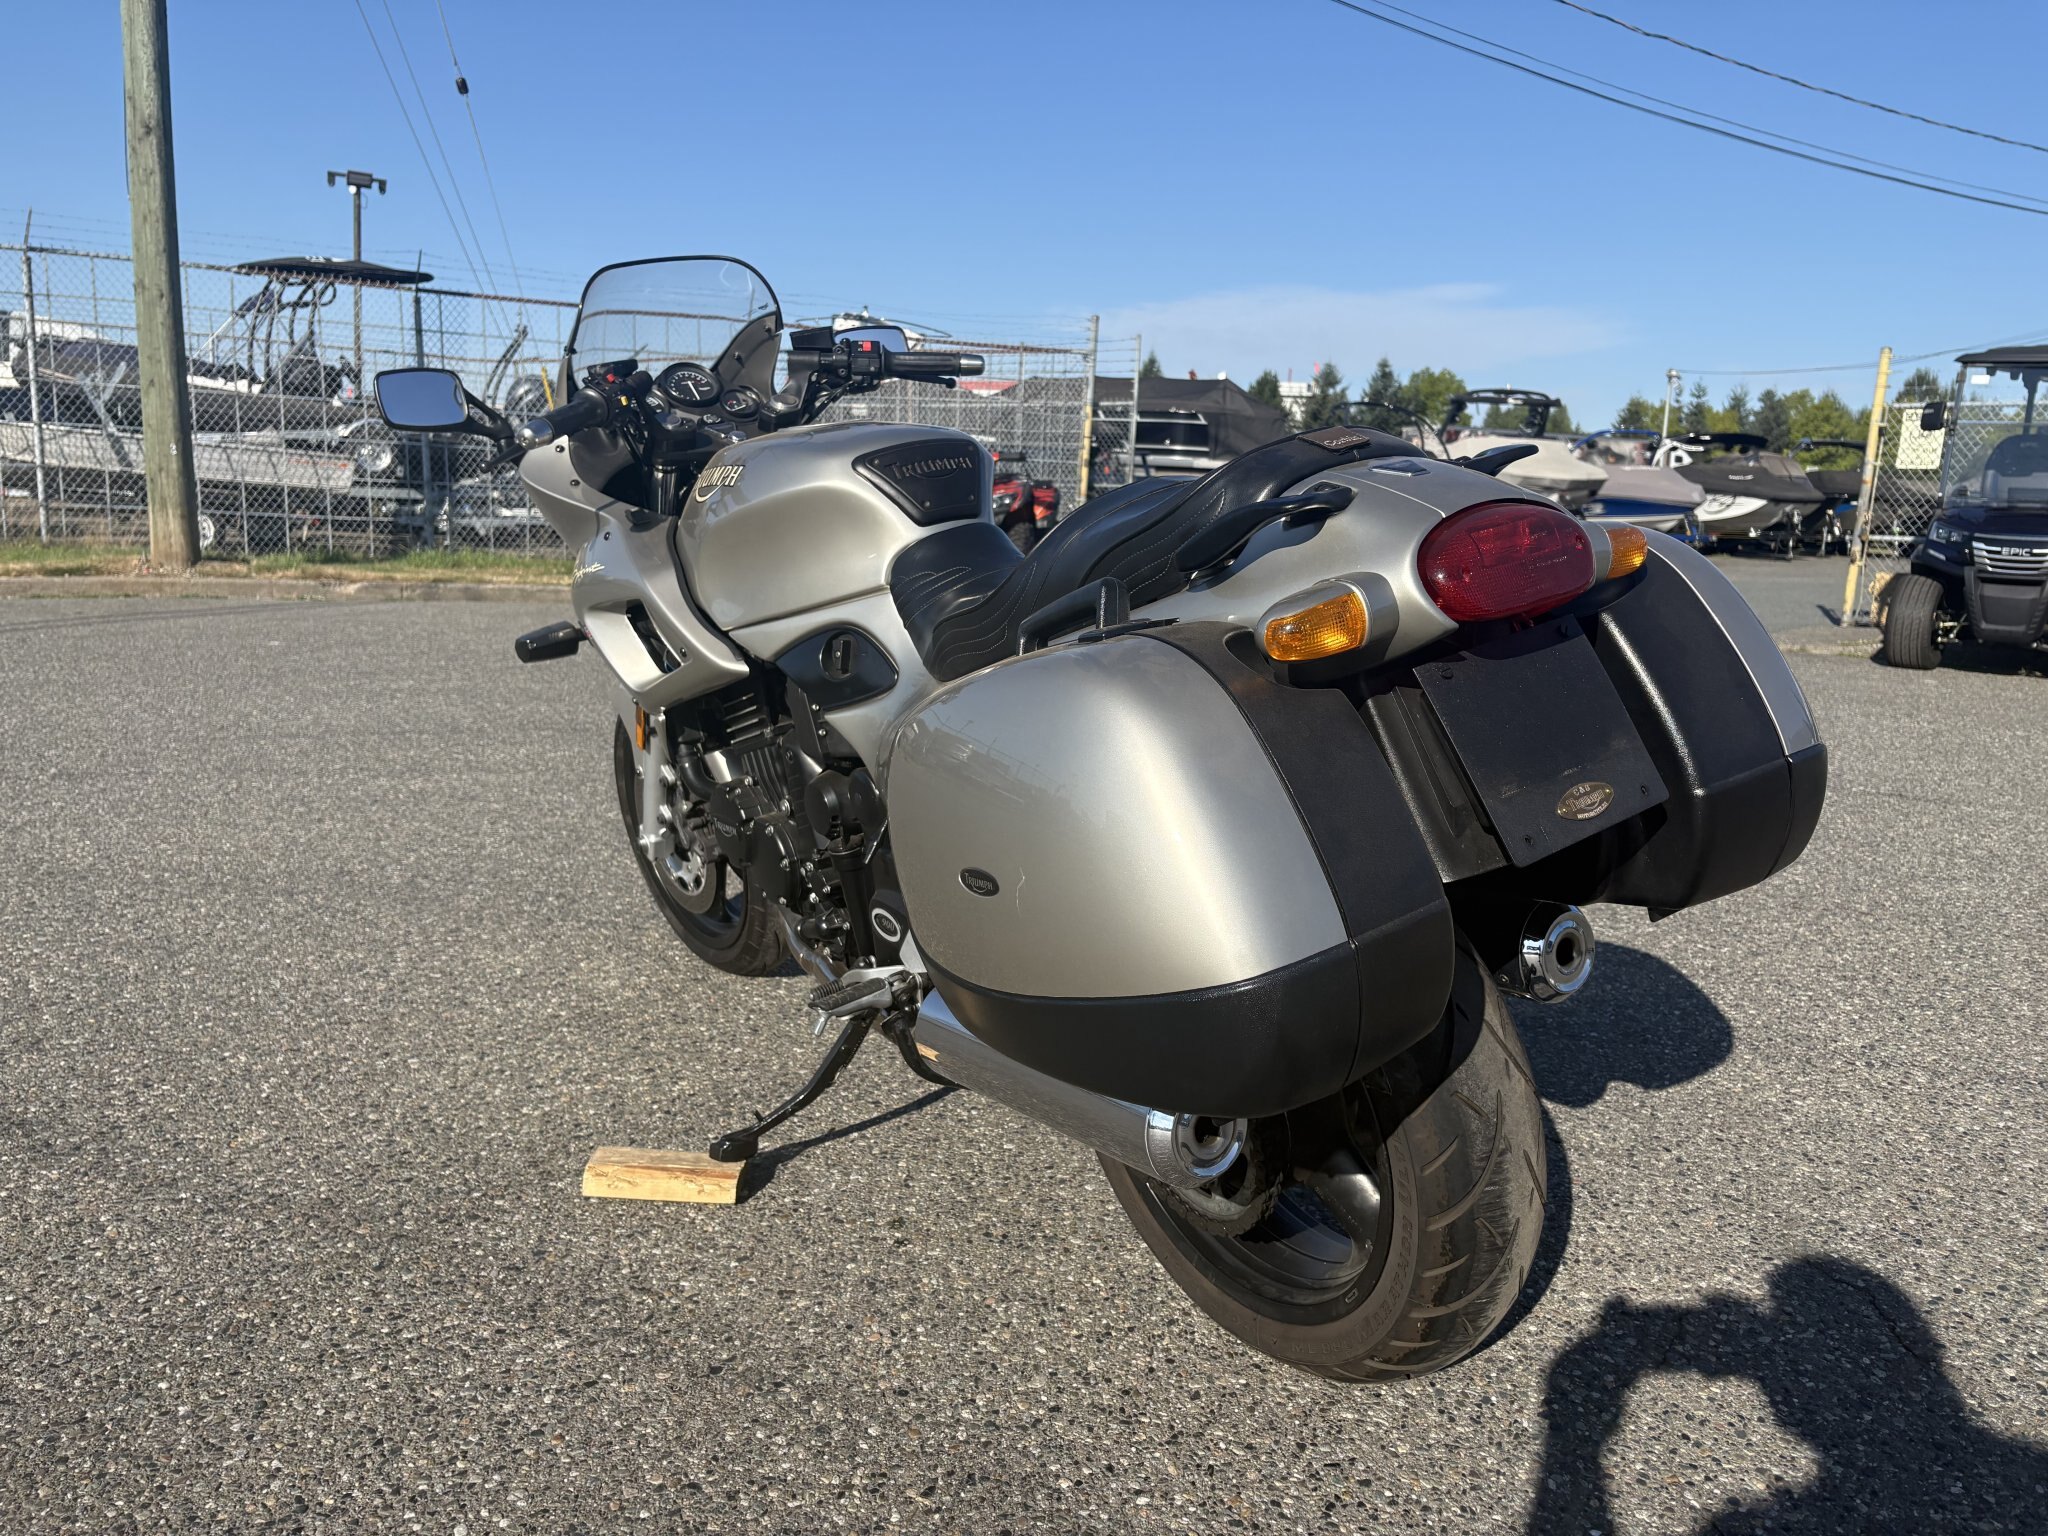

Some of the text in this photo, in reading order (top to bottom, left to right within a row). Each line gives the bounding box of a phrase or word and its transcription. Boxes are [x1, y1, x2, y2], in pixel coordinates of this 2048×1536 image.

[884, 457, 972, 480] TRIUMPH
[2001, 546, 2031, 557] EPIC
[964, 872, 993, 893] TRIUMPH
